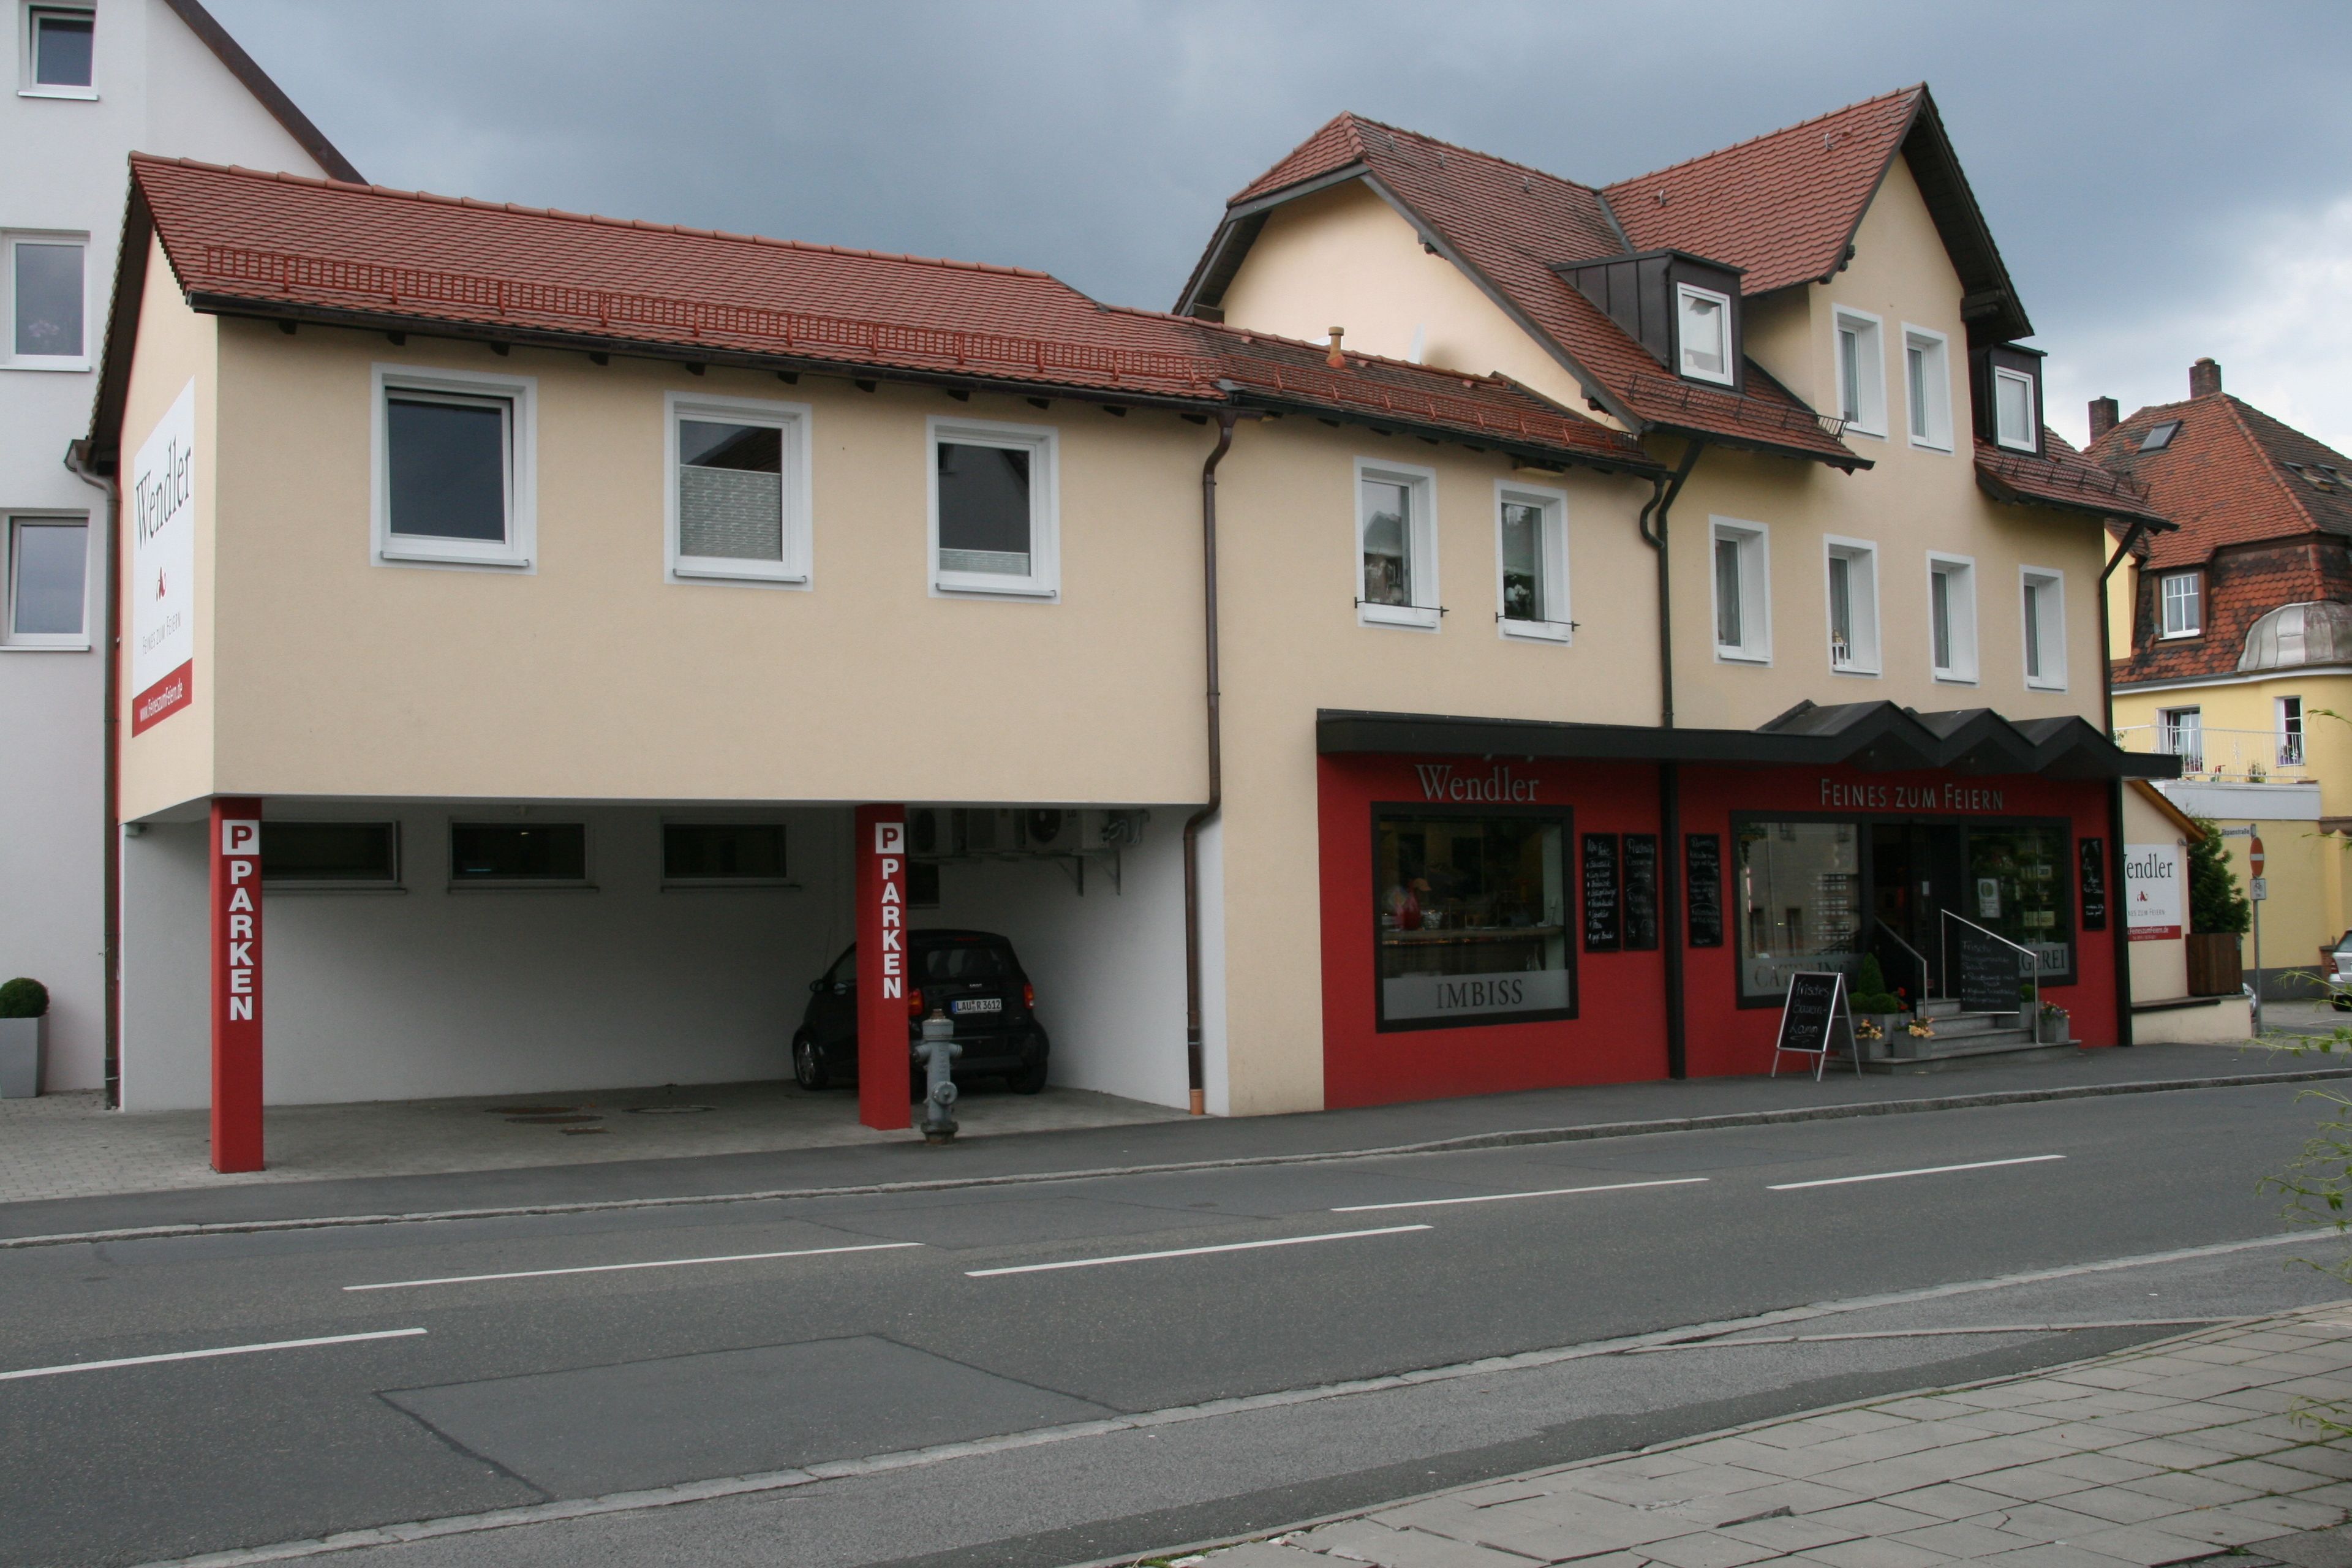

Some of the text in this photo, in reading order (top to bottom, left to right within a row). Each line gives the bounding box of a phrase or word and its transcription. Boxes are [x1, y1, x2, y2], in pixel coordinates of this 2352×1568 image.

[136, 434, 191, 550] Wendler
[1414, 764, 1539, 802] Wendler
[1821, 778, 2002, 810] FEINES ZUM FEIERN
[232, 826, 252, 849] P
[882, 827, 899, 848] P
[2124, 853, 2173, 879] endler
[229, 861, 254, 1021] PARKEN
[881, 859, 902, 999] PARKEN
[957, 1000, 1000, 1011] LAU R 3612
[1436, 979, 1523, 1009] IMBISS
